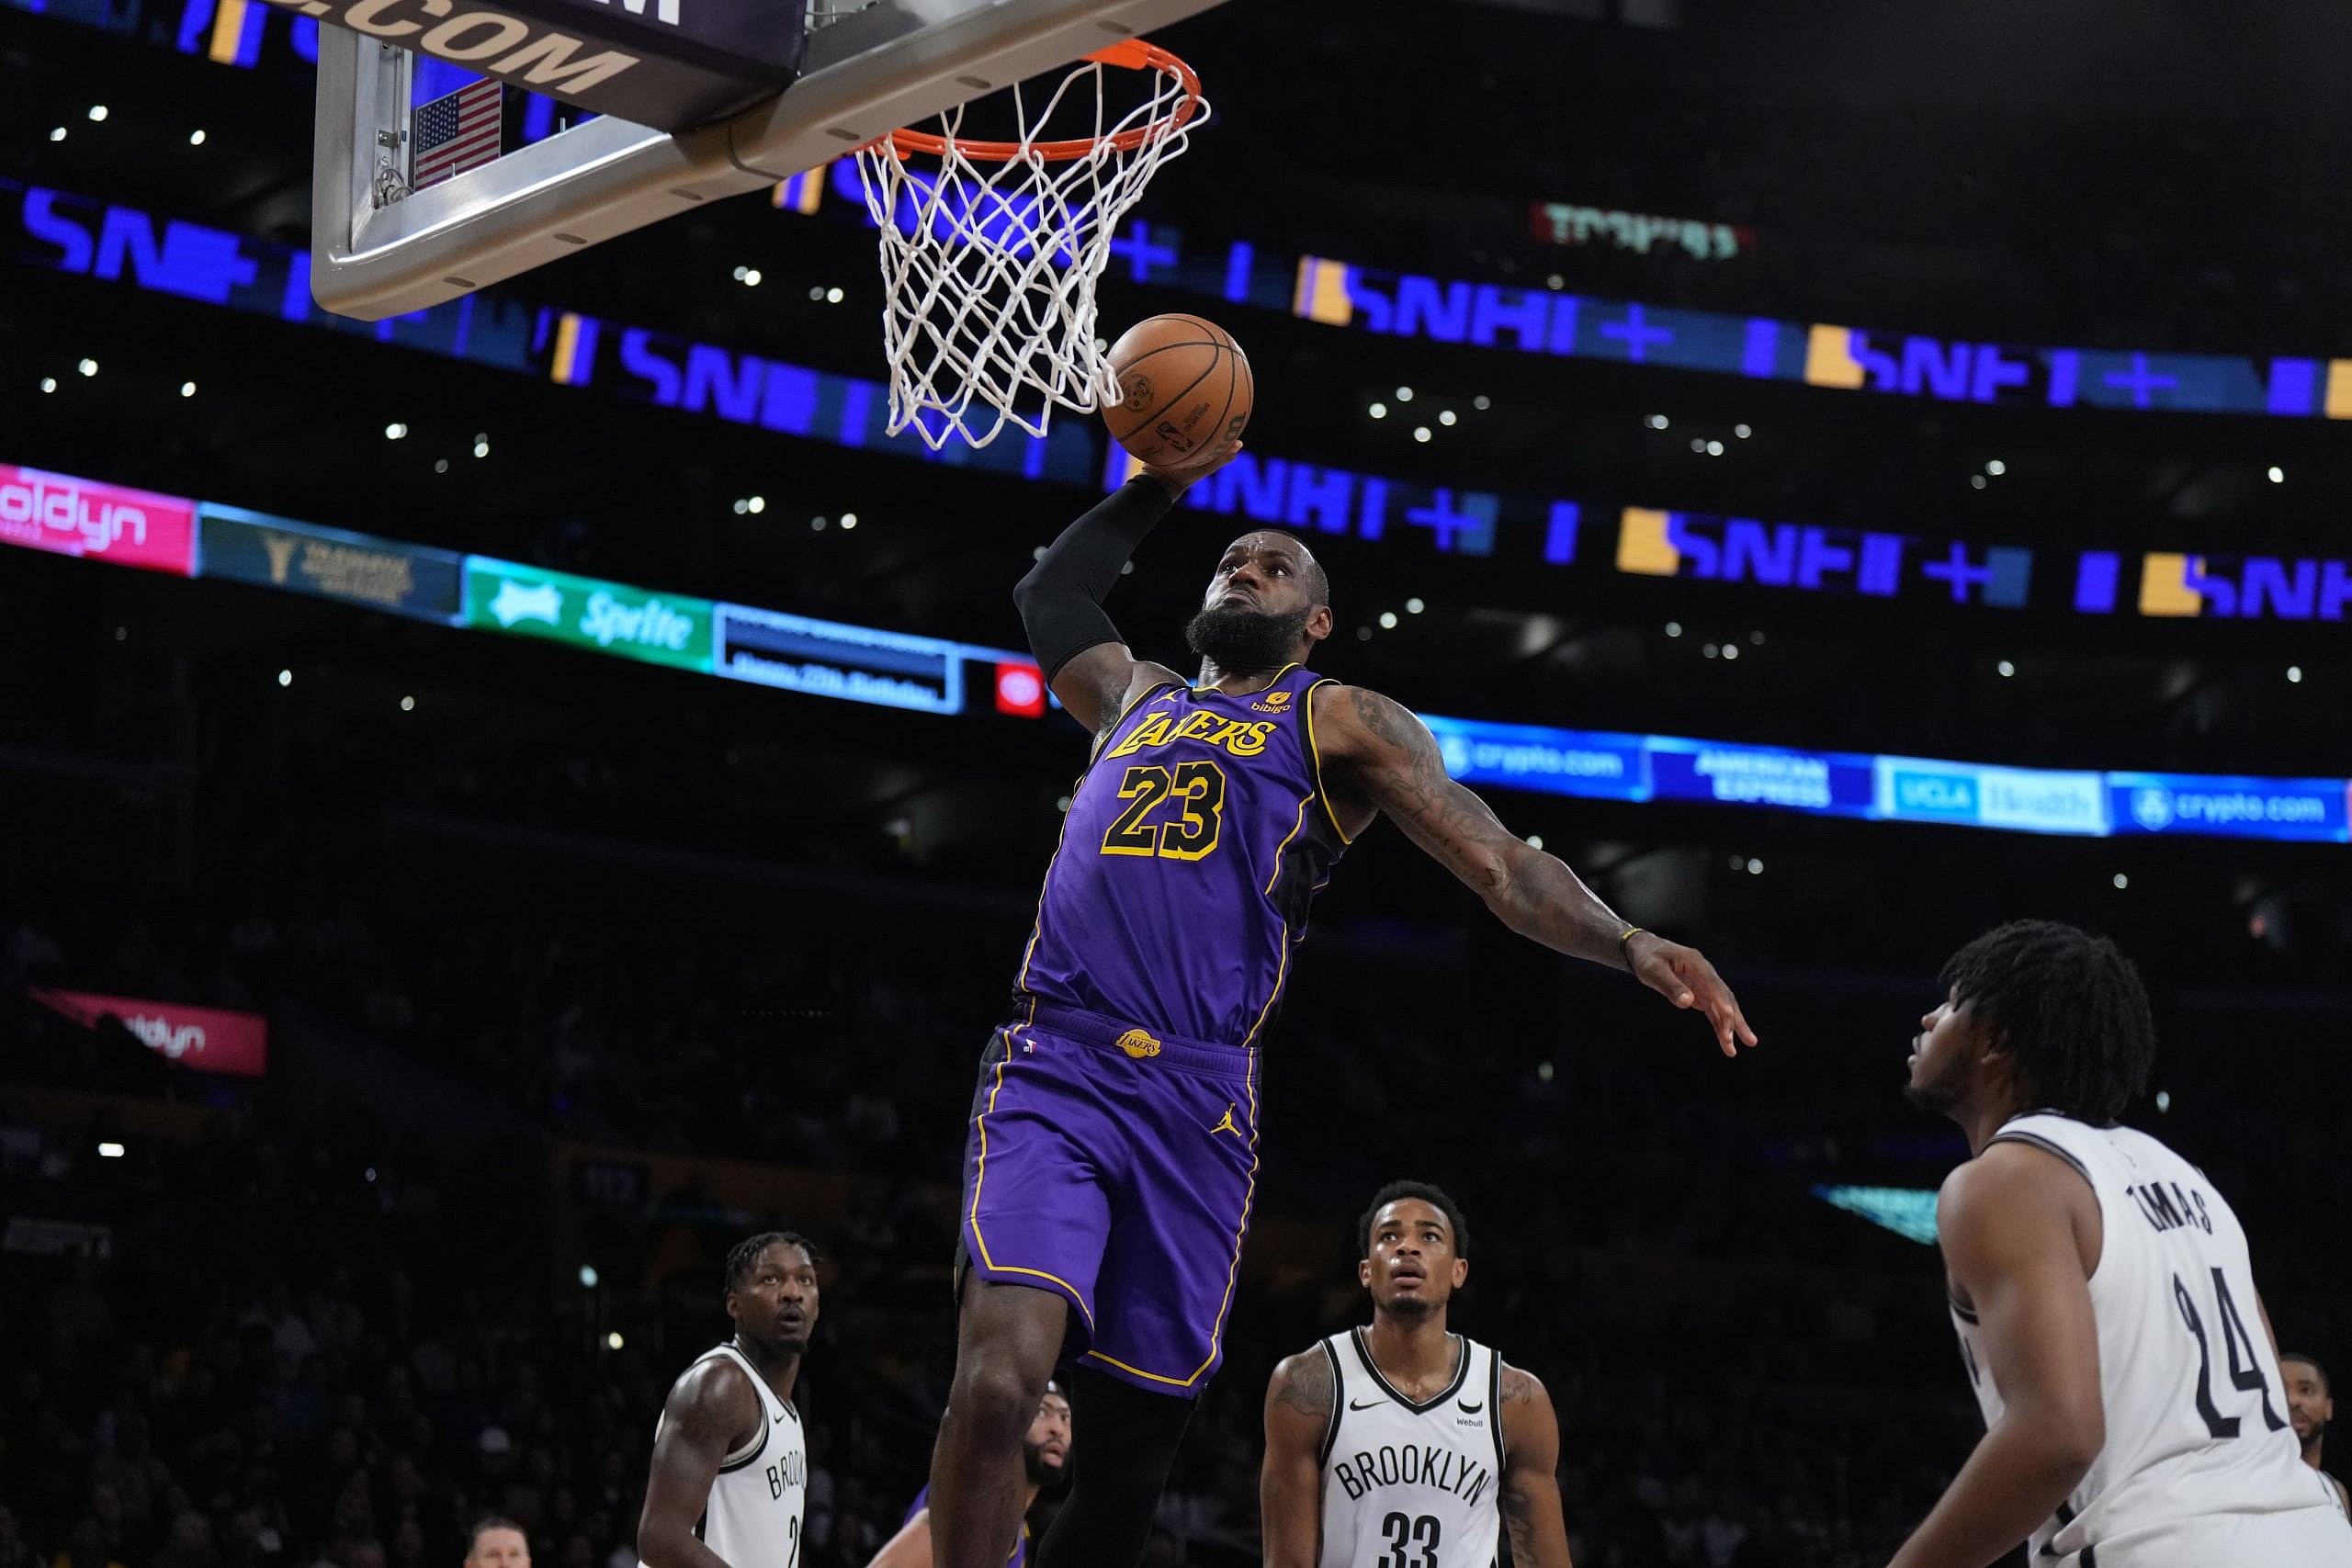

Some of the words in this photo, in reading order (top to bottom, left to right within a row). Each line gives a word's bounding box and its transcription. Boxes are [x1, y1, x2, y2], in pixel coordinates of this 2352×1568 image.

[579, 589, 696, 653] Sprite
[1250, 702, 1291, 714] bibigo
[1104, 710, 1277, 761] LAKERS
[1476, 740, 1623, 778] crypto.com
[1693, 749, 1830, 777] AMERICAN
[1712, 774, 1832, 808] EXPRESS
[1899, 776, 1974, 810] UCLA
[1100, 761, 1227, 862] 23
[2177, 792, 2326, 825] crypto.com
[1117, 1033, 1159, 1056] LAKERS
[1456, 1417, 1484, 1428] Webull
[1334, 1444, 1492, 1507] BROOKLYN
[1378, 1511, 1442, 1568] 33
